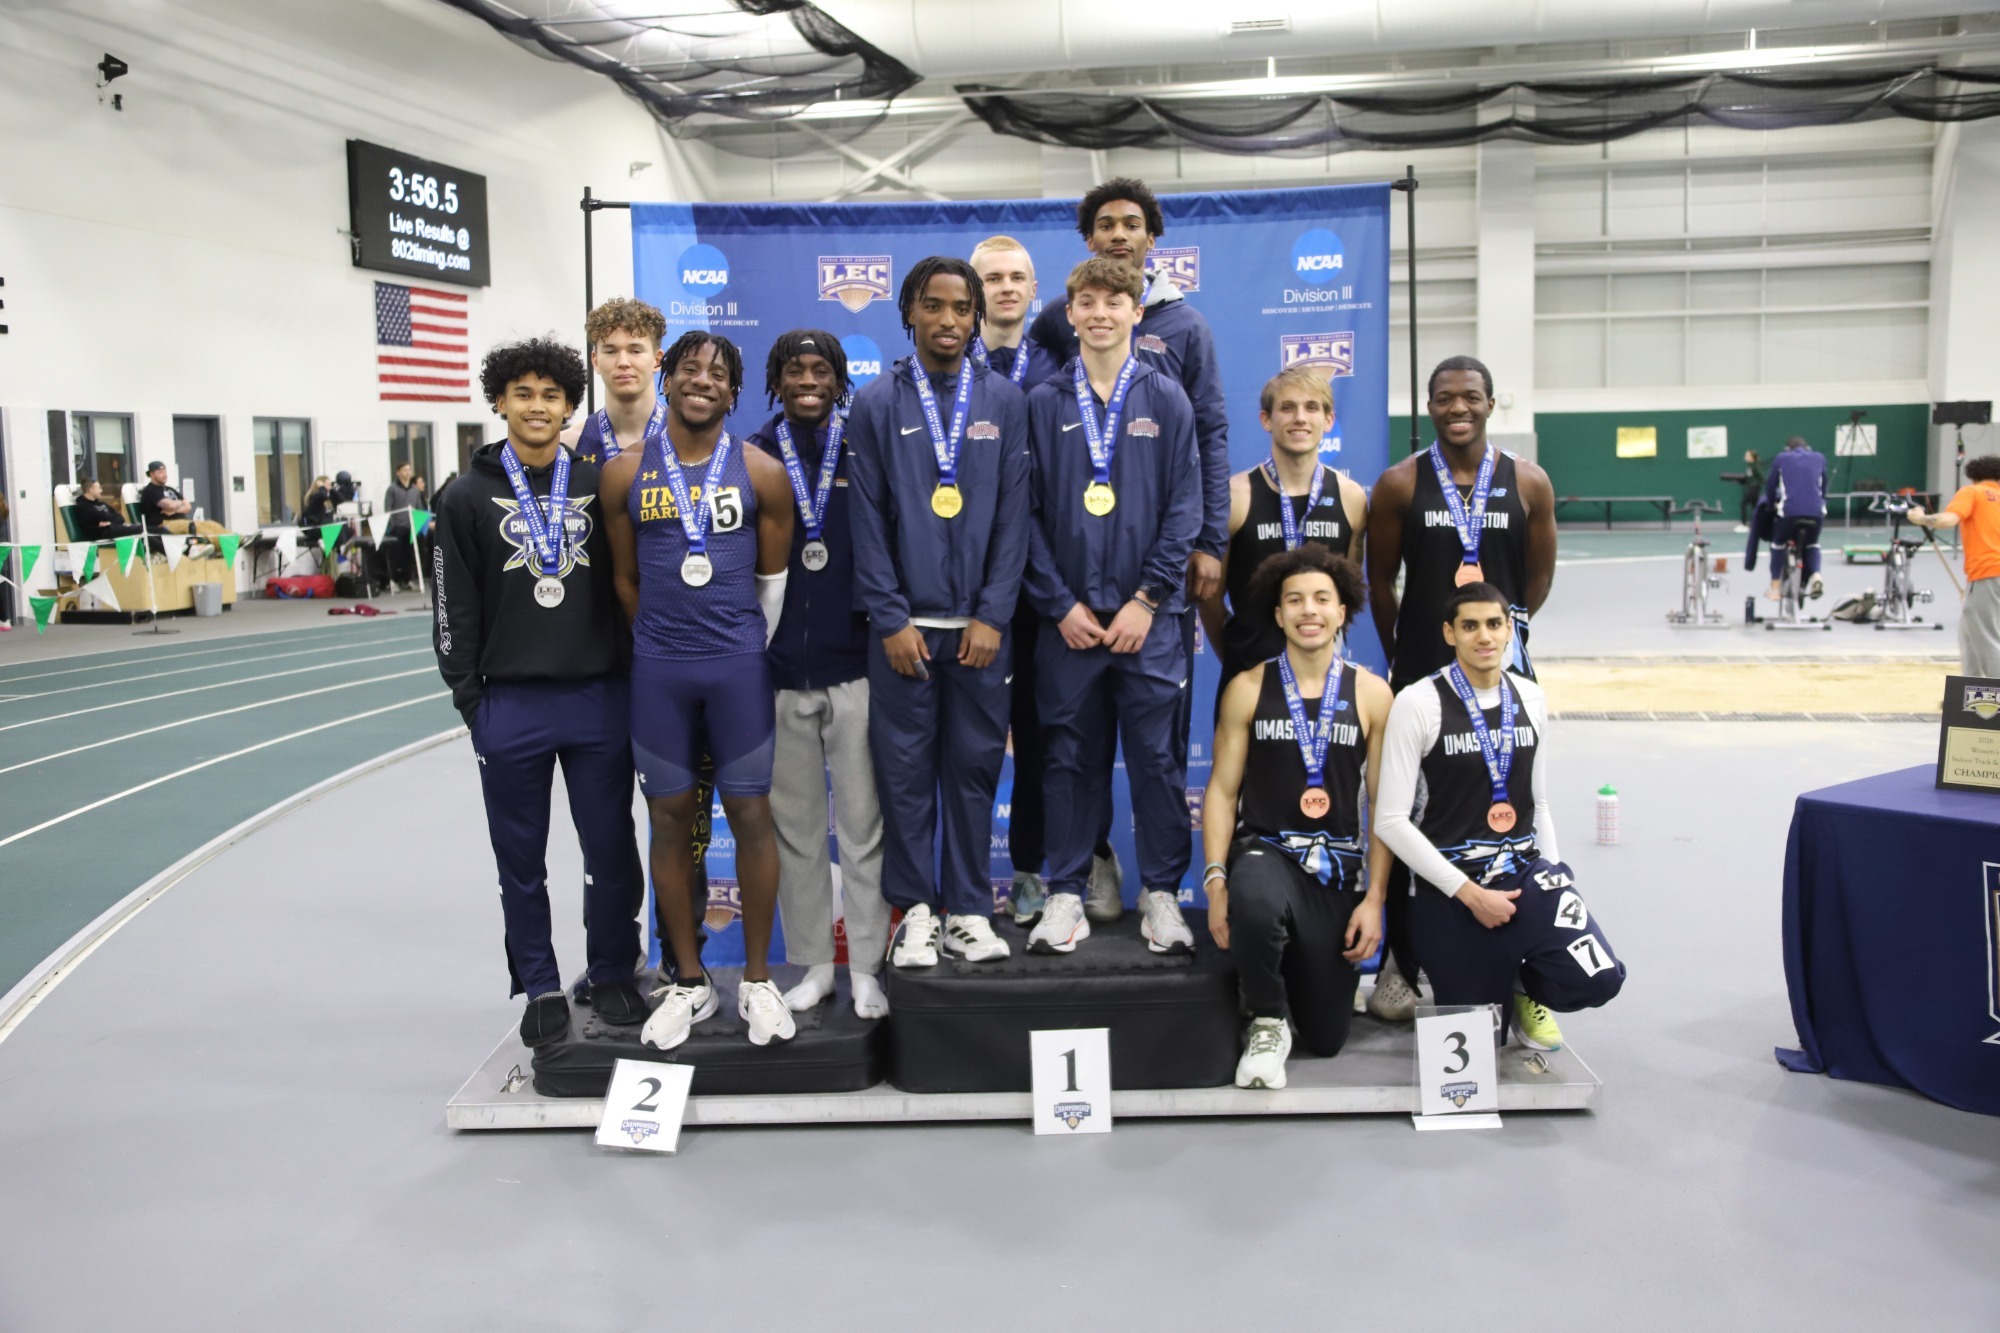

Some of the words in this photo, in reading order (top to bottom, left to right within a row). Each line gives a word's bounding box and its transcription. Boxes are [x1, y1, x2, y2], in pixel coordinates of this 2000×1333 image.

[389, 167, 459, 214] 3:56.5
[389, 212, 413, 235] Live
[415, 218, 456, 244] Results
[456, 228, 470, 250] @
[391, 238, 471, 271] 802timing.com
[1296, 254, 1343, 271] NCAA
[682, 269, 728, 284] NCAA
[823, 264, 887, 287] LEC
[1284, 288, 1338, 304] Division
[1342, 286, 1352, 300] III
[670, 302, 723, 316] Division
[726, 302, 738, 316] III
[1285, 341, 1350, 367] LEC
[846, 360, 880, 375] CAA
[714, 493, 738, 529] 5
[1257, 522, 1282, 540] UMA
[1304, 521, 1339, 538] OSTON
[1255, 720, 1298, 740] UMAS
[1444, 732, 1481, 755] UMAS
[1560, 898, 1582, 926] 4
[1572, 938, 1601, 969] 7
[1444, 1031, 1470, 1074] 3
[1059, 1048, 1084, 1092] 1
[630, 1076, 662, 1112] 2
[1441, 1083, 1477, 1094] CHAMPIONSHIP
[1055, 1104, 1090, 1114] CHAMPIONSHIP
[622, 1121, 660, 1131] CHAMPIONSHIP
